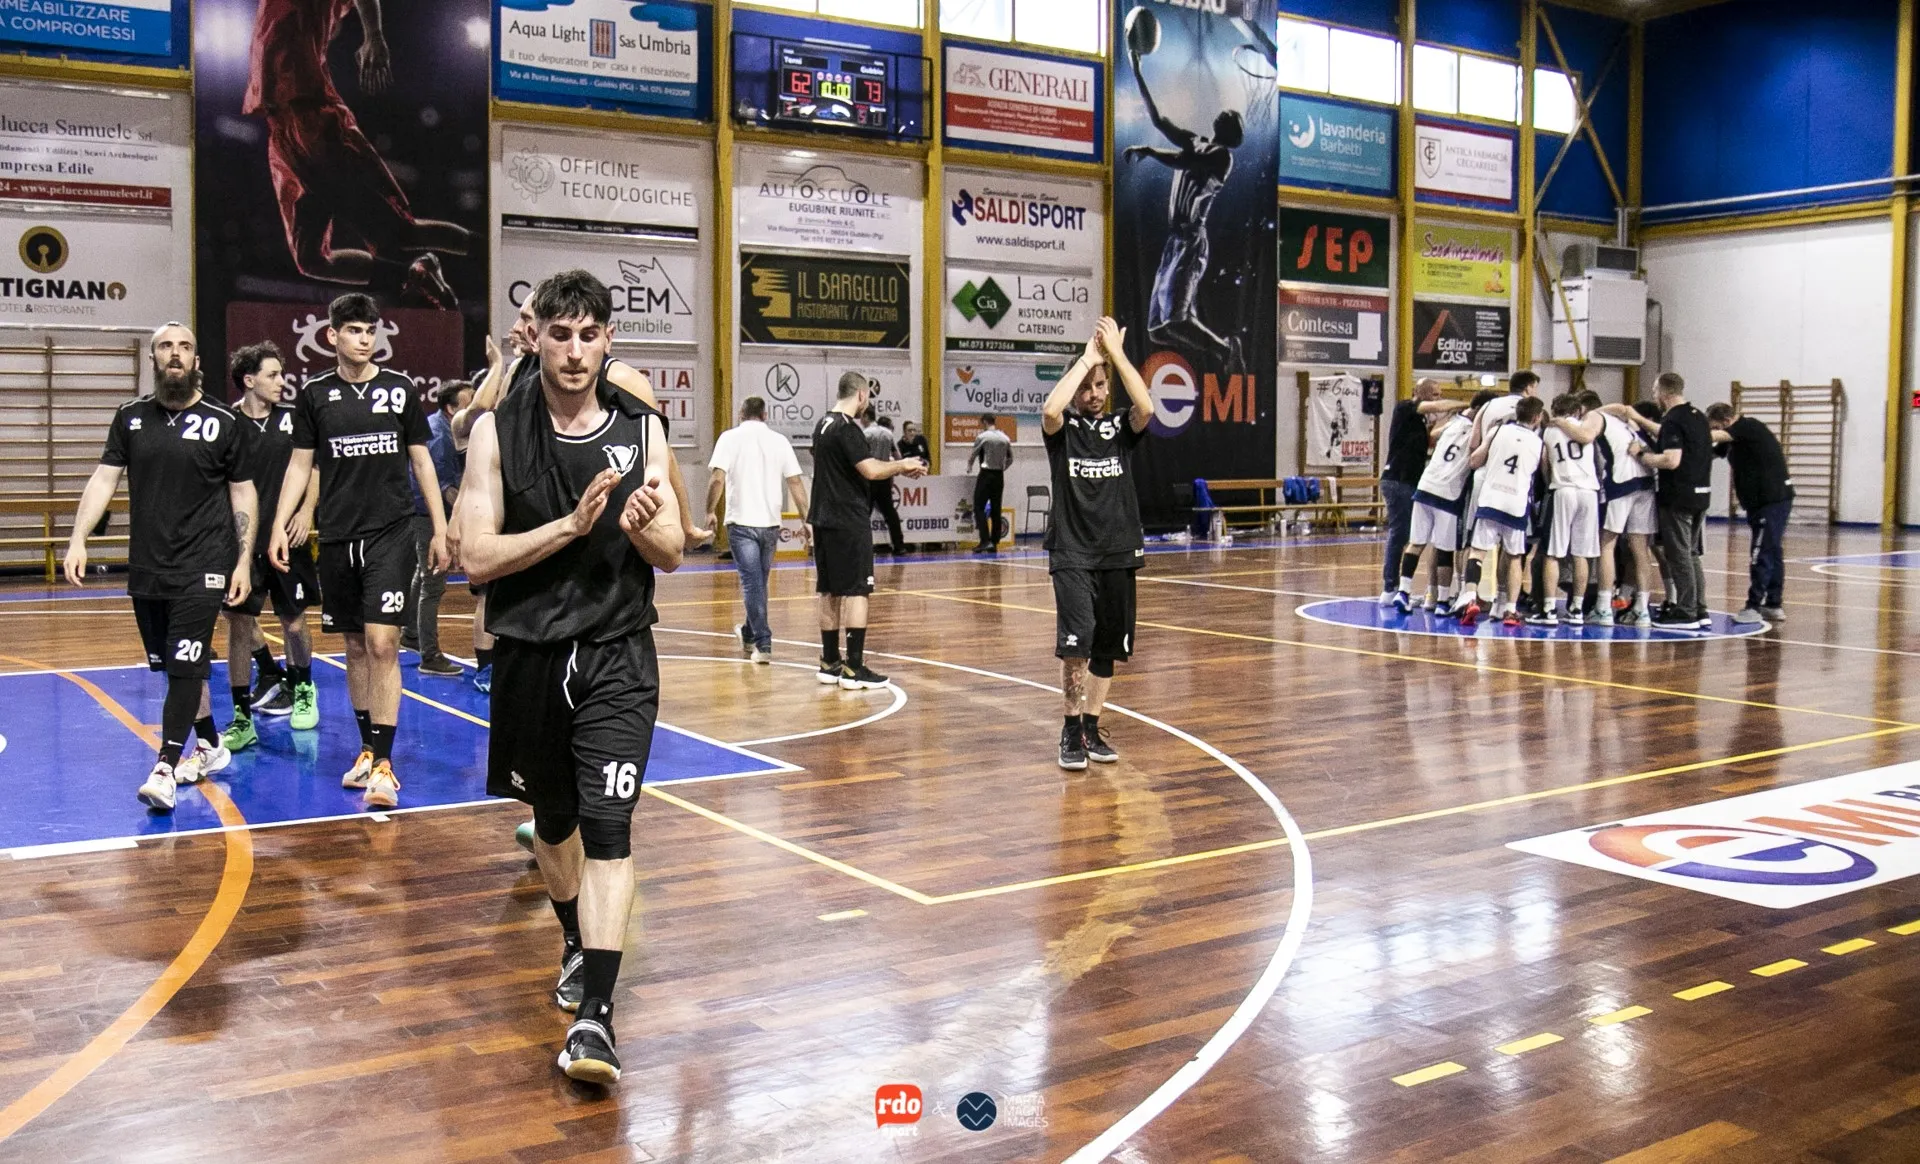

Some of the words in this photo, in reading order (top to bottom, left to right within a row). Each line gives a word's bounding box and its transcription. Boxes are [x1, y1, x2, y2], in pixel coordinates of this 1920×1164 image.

[11, 16, 136, 41] COMPROMESSI
[509, 20, 547, 38] Aqua
[552, 24, 586, 43] Light
[619, 35, 636, 48] Sas
[639, 35, 691, 55] Umbria
[518, 51, 535, 62] tuo
[538, 53, 589, 69] depuratore
[592, 61, 606, 75] per
[611, 64, 629, 72] casa
[640, 66, 691, 80] ristorazione
[791, 72, 811, 94] 62
[863, 80, 882, 102] 73
[988, 67, 1088, 103] GENERALI
[1320, 117, 1385, 144] lavanderia
[1320, 138, 1362, 156] Barbetti
[58, 162, 94, 175] Edile
[560, 157, 640, 179] OFFICINE
[561, 181, 693, 206] TECNOLOGICHE
[759, 182, 891, 206] AUTOSCUOLE
[789, 202, 836, 216] EUGUBINE
[839, 206, 875, 219] RIUNITE
[976, 235, 1065, 251] www.saldisport.it
[1297, 224, 1373, 273] SEP
[798, 271, 812, 299] IL
[818, 272, 898, 304] BARGELLO
[1017, 276, 1046, 300] La
[1052, 278, 1089, 304] Cia
[797, 303, 848, 320] RISTORANTE
[1018, 308, 1072, 321] RISTORANTE
[1287, 310, 1353, 335] Contessa
[1018, 323, 1065, 335] CATERING
[1437, 338, 1472, 351] Edilizia
[1441, 351, 1468, 364] CASA
[371, 388, 406, 414] 29
[966, 387, 1008, 408] Voglia
[1012, 388, 1024, 403] di
[182, 413, 220, 442] 20
[279, 412, 294, 434] 4
[329, 433, 399, 458] Ferretti
[1444, 444, 1460, 462] 6
[1555, 440, 1583, 463] 10
[1504, 455, 1519, 474] 4
[906, 518, 950, 531] GUBBIO
[381, 591, 404, 613] 29
[175, 639, 203, 662] 20
[603, 761, 637, 799] 16
